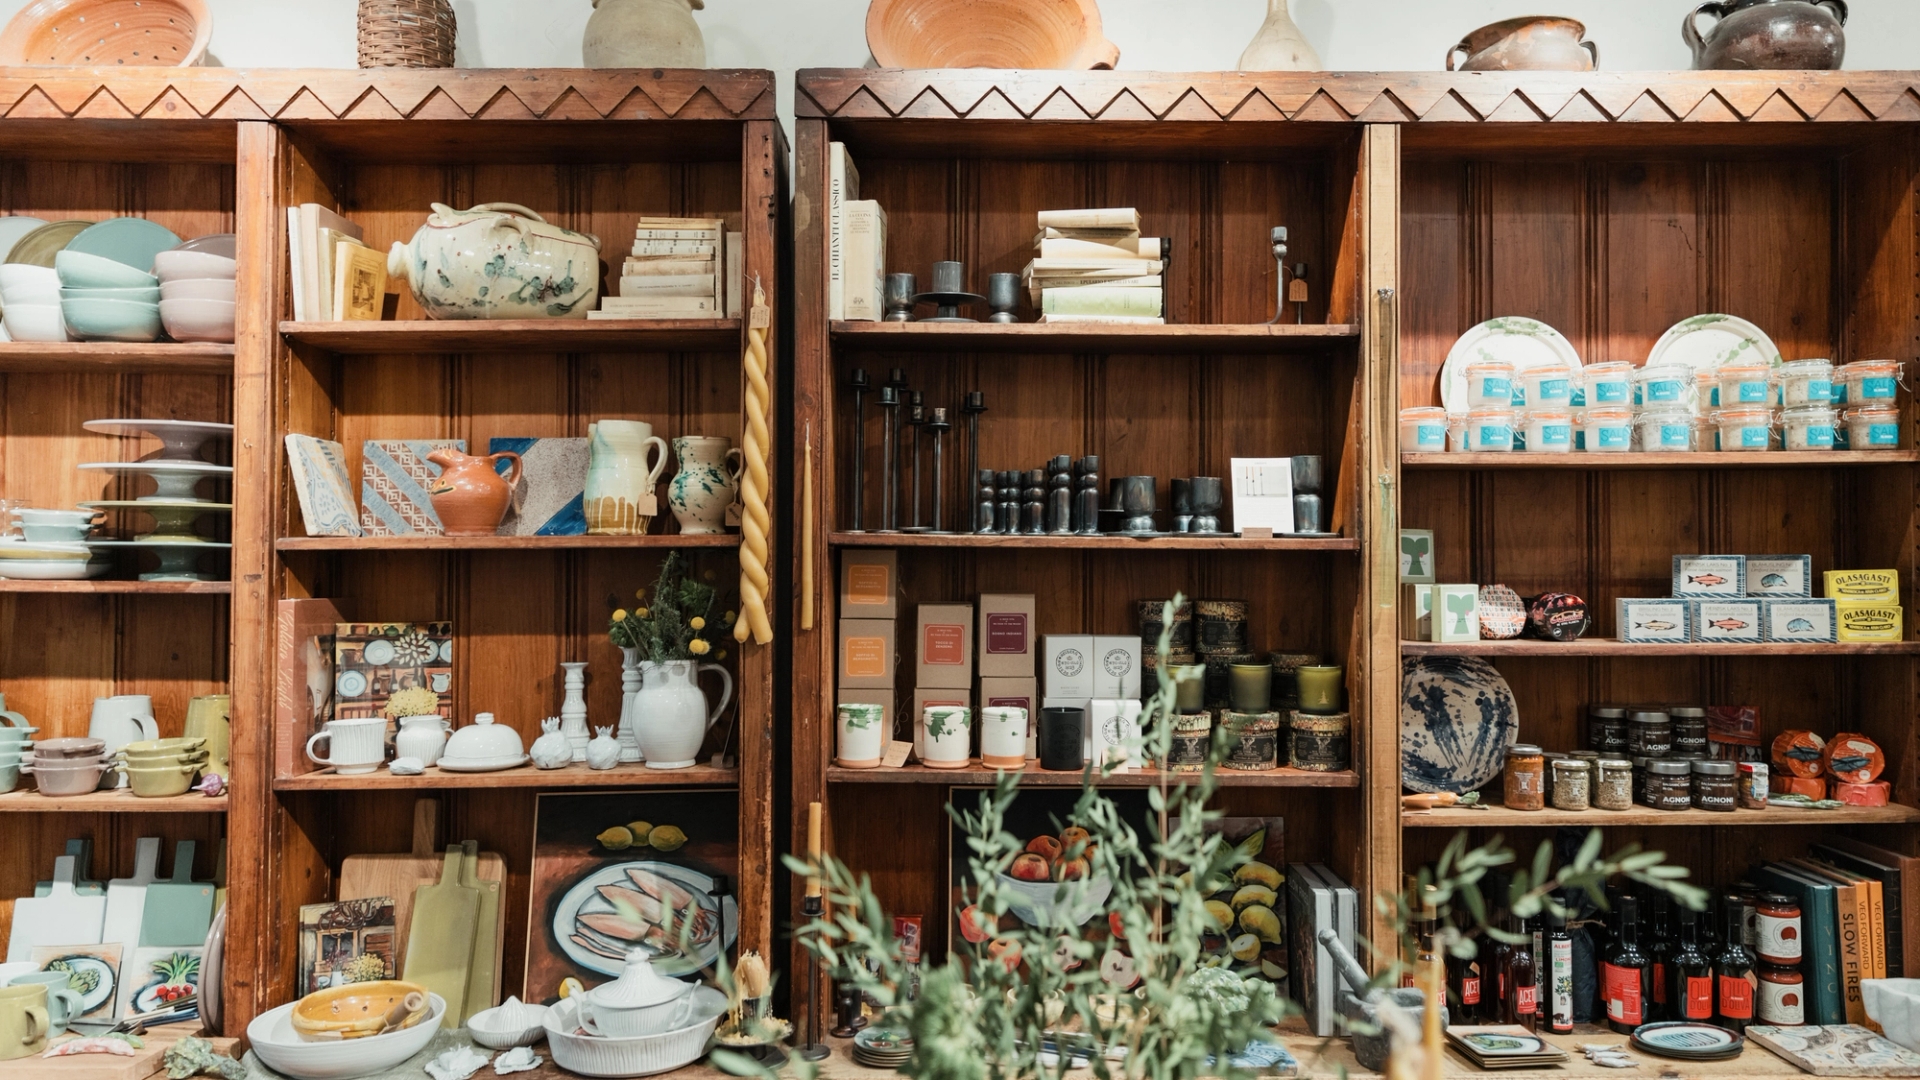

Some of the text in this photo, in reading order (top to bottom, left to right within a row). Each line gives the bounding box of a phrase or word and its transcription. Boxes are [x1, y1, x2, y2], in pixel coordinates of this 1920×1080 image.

[832, 270, 839, 280] IL
[1541, 381, 1569, 395] SALE
[1597, 383, 1625, 397] SALE
[1649, 381, 1676, 396] SALE
[1810, 382, 1830, 395] SAL
[1835, 573, 1891, 585] OLASAGASTI
[1844, 609, 1896, 620] OLASAGASTI
[278, 608, 293, 660] Golden
[277, 668, 292, 711] Light
[1858, 900, 1870, 970] VEG FORWARD
[1874, 900, 1884, 970] VEG FORWARD
[1843, 913, 1860, 1003] SLOW FIRES
[1465, 980, 1480, 997] ACET
[1519, 987, 1536, 1006] ACET
[1722, 979, 1750, 999] OLIO
[1722, 998, 1750, 1011] D'OLIVA
